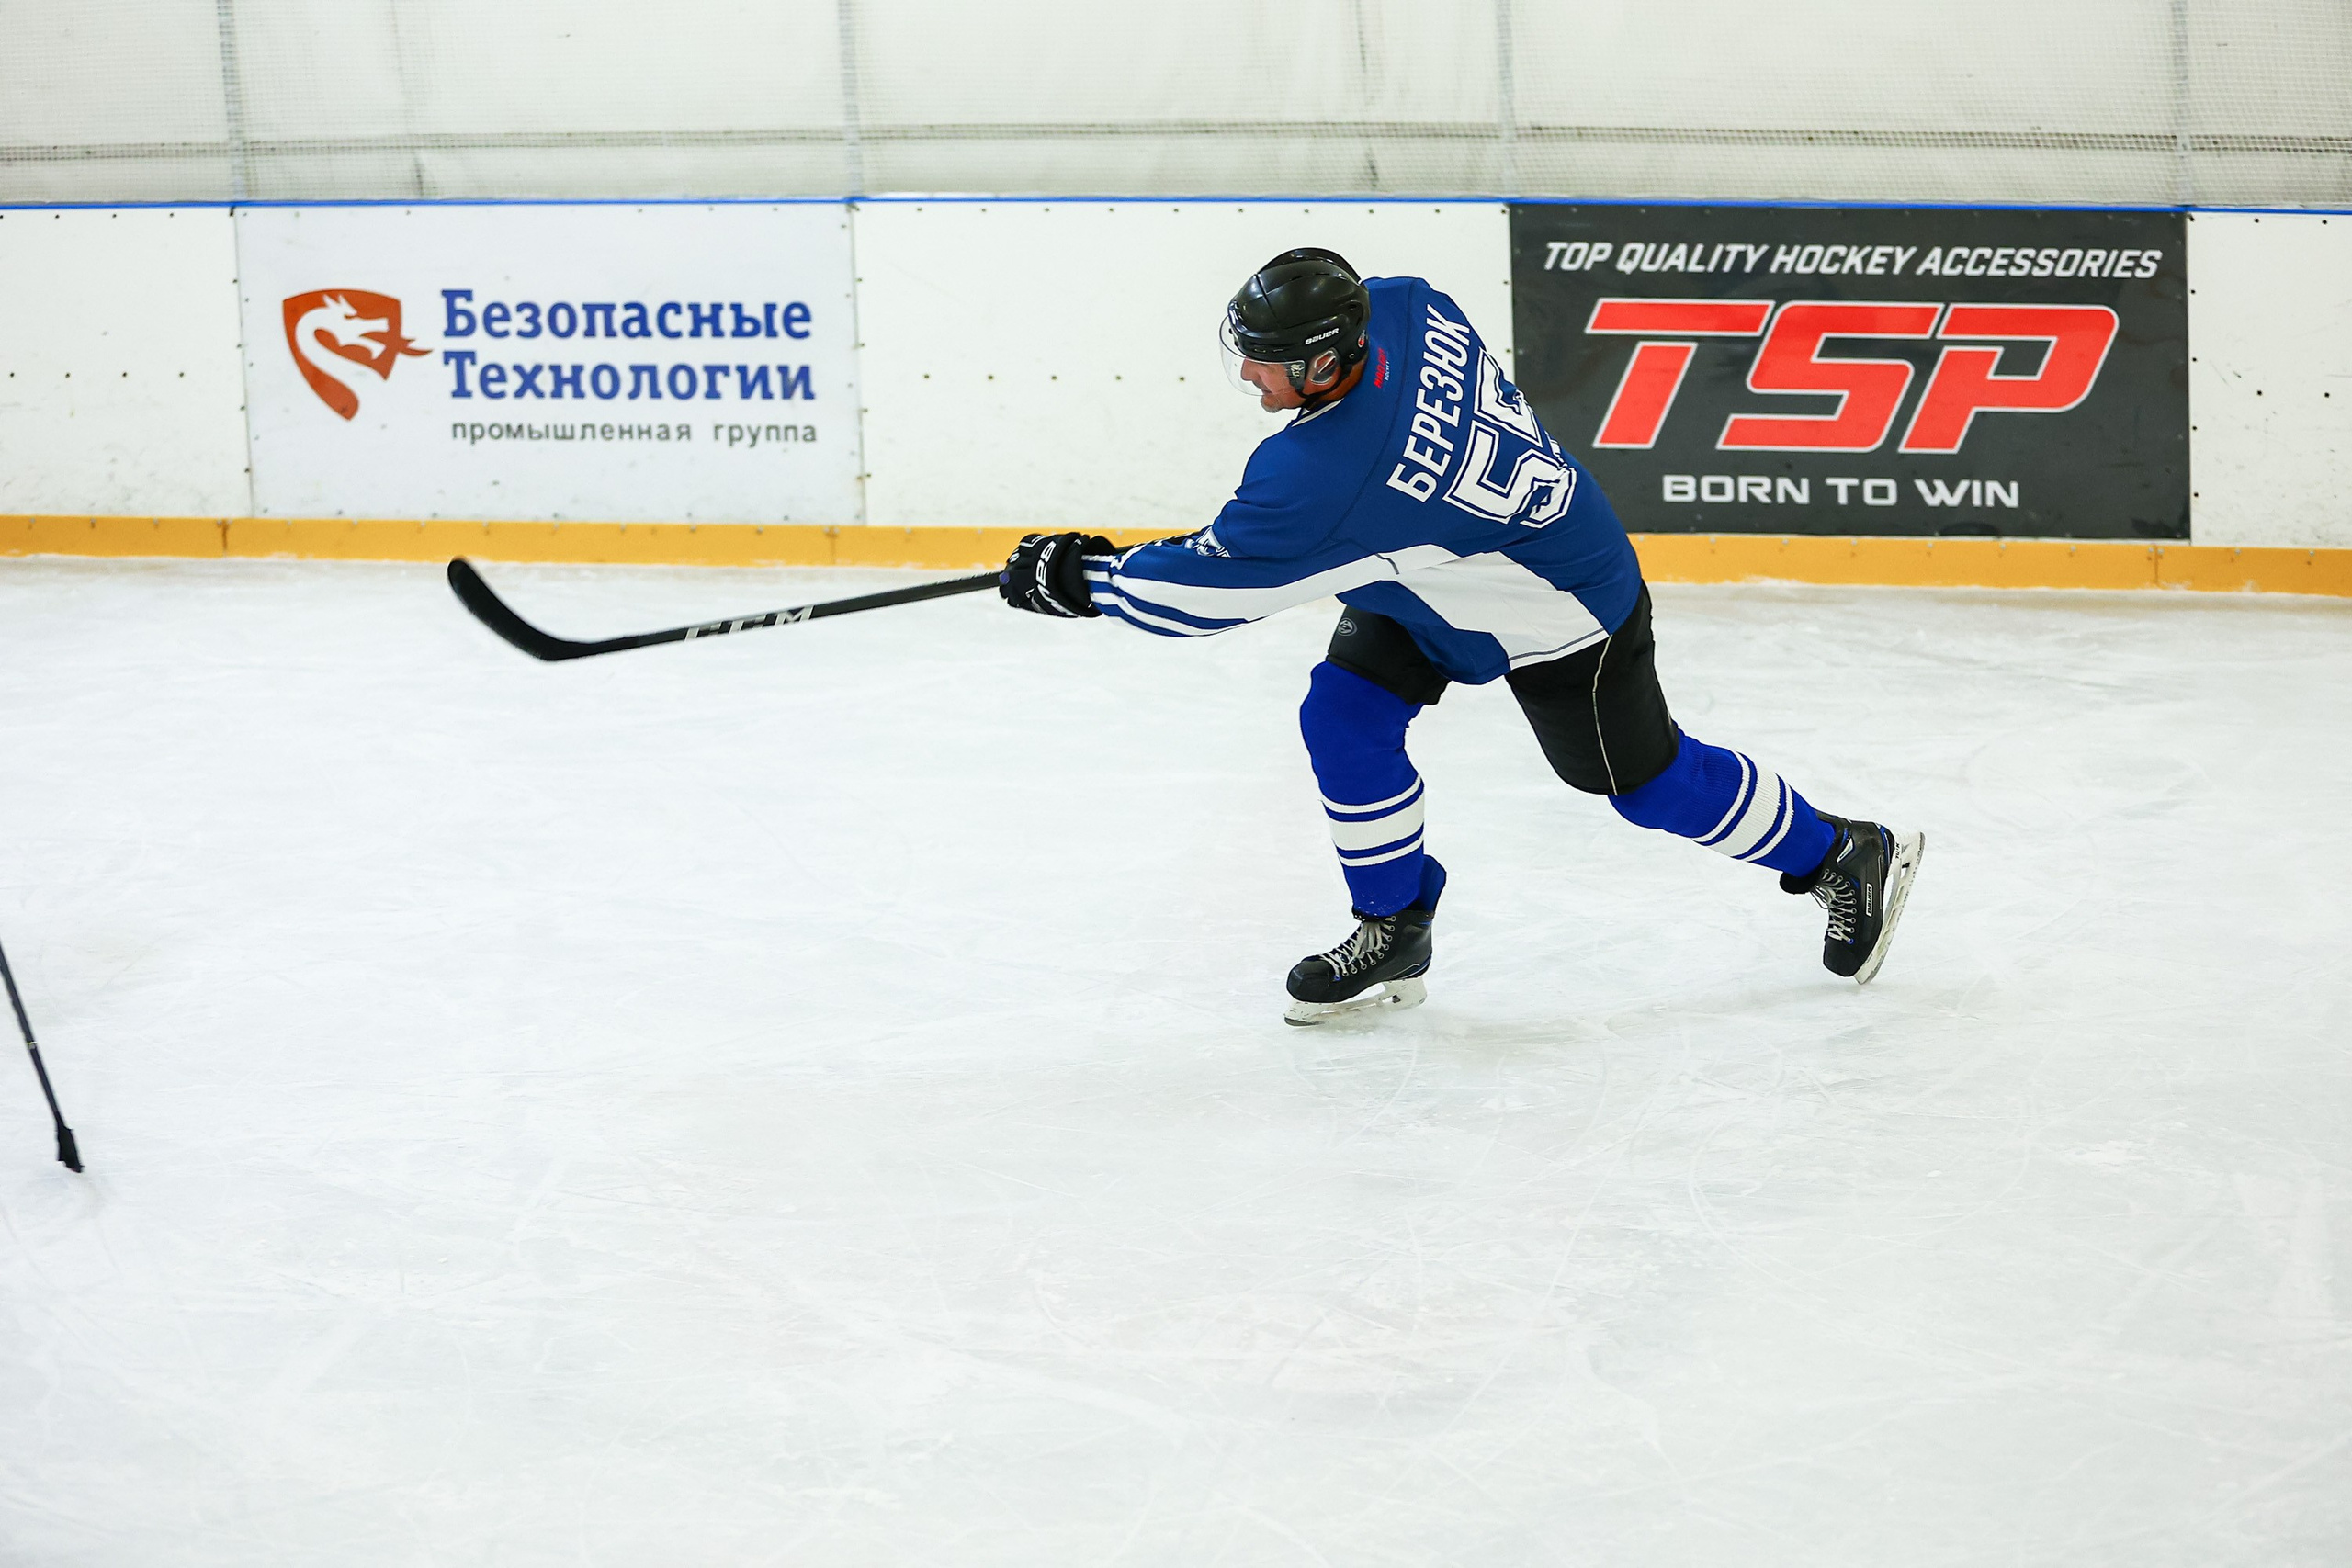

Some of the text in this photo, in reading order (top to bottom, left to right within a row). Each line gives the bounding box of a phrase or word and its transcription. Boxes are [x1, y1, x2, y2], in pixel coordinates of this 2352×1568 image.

[1544, 242, 2163, 279] TOP QUALITY HOCKEY ACCESSORIES
[441, 289, 812, 340] Безопасные
[1305, 327, 1340, 345] BAUER
[442, 350, 816, 400] Технологии
[1585, 298, 2120, 455] TSP
[1386, 304, 1471, 503] БЕРЕЗЮК
[451, 420, 818, 447] промышленная группа
[1442, 346, 1577, 529] 55
[1663, 475, 2019, 508] BORN TO WIN
[1035, 540, 1080, 617] BAU
[684, 604, 815, 642] CCM
